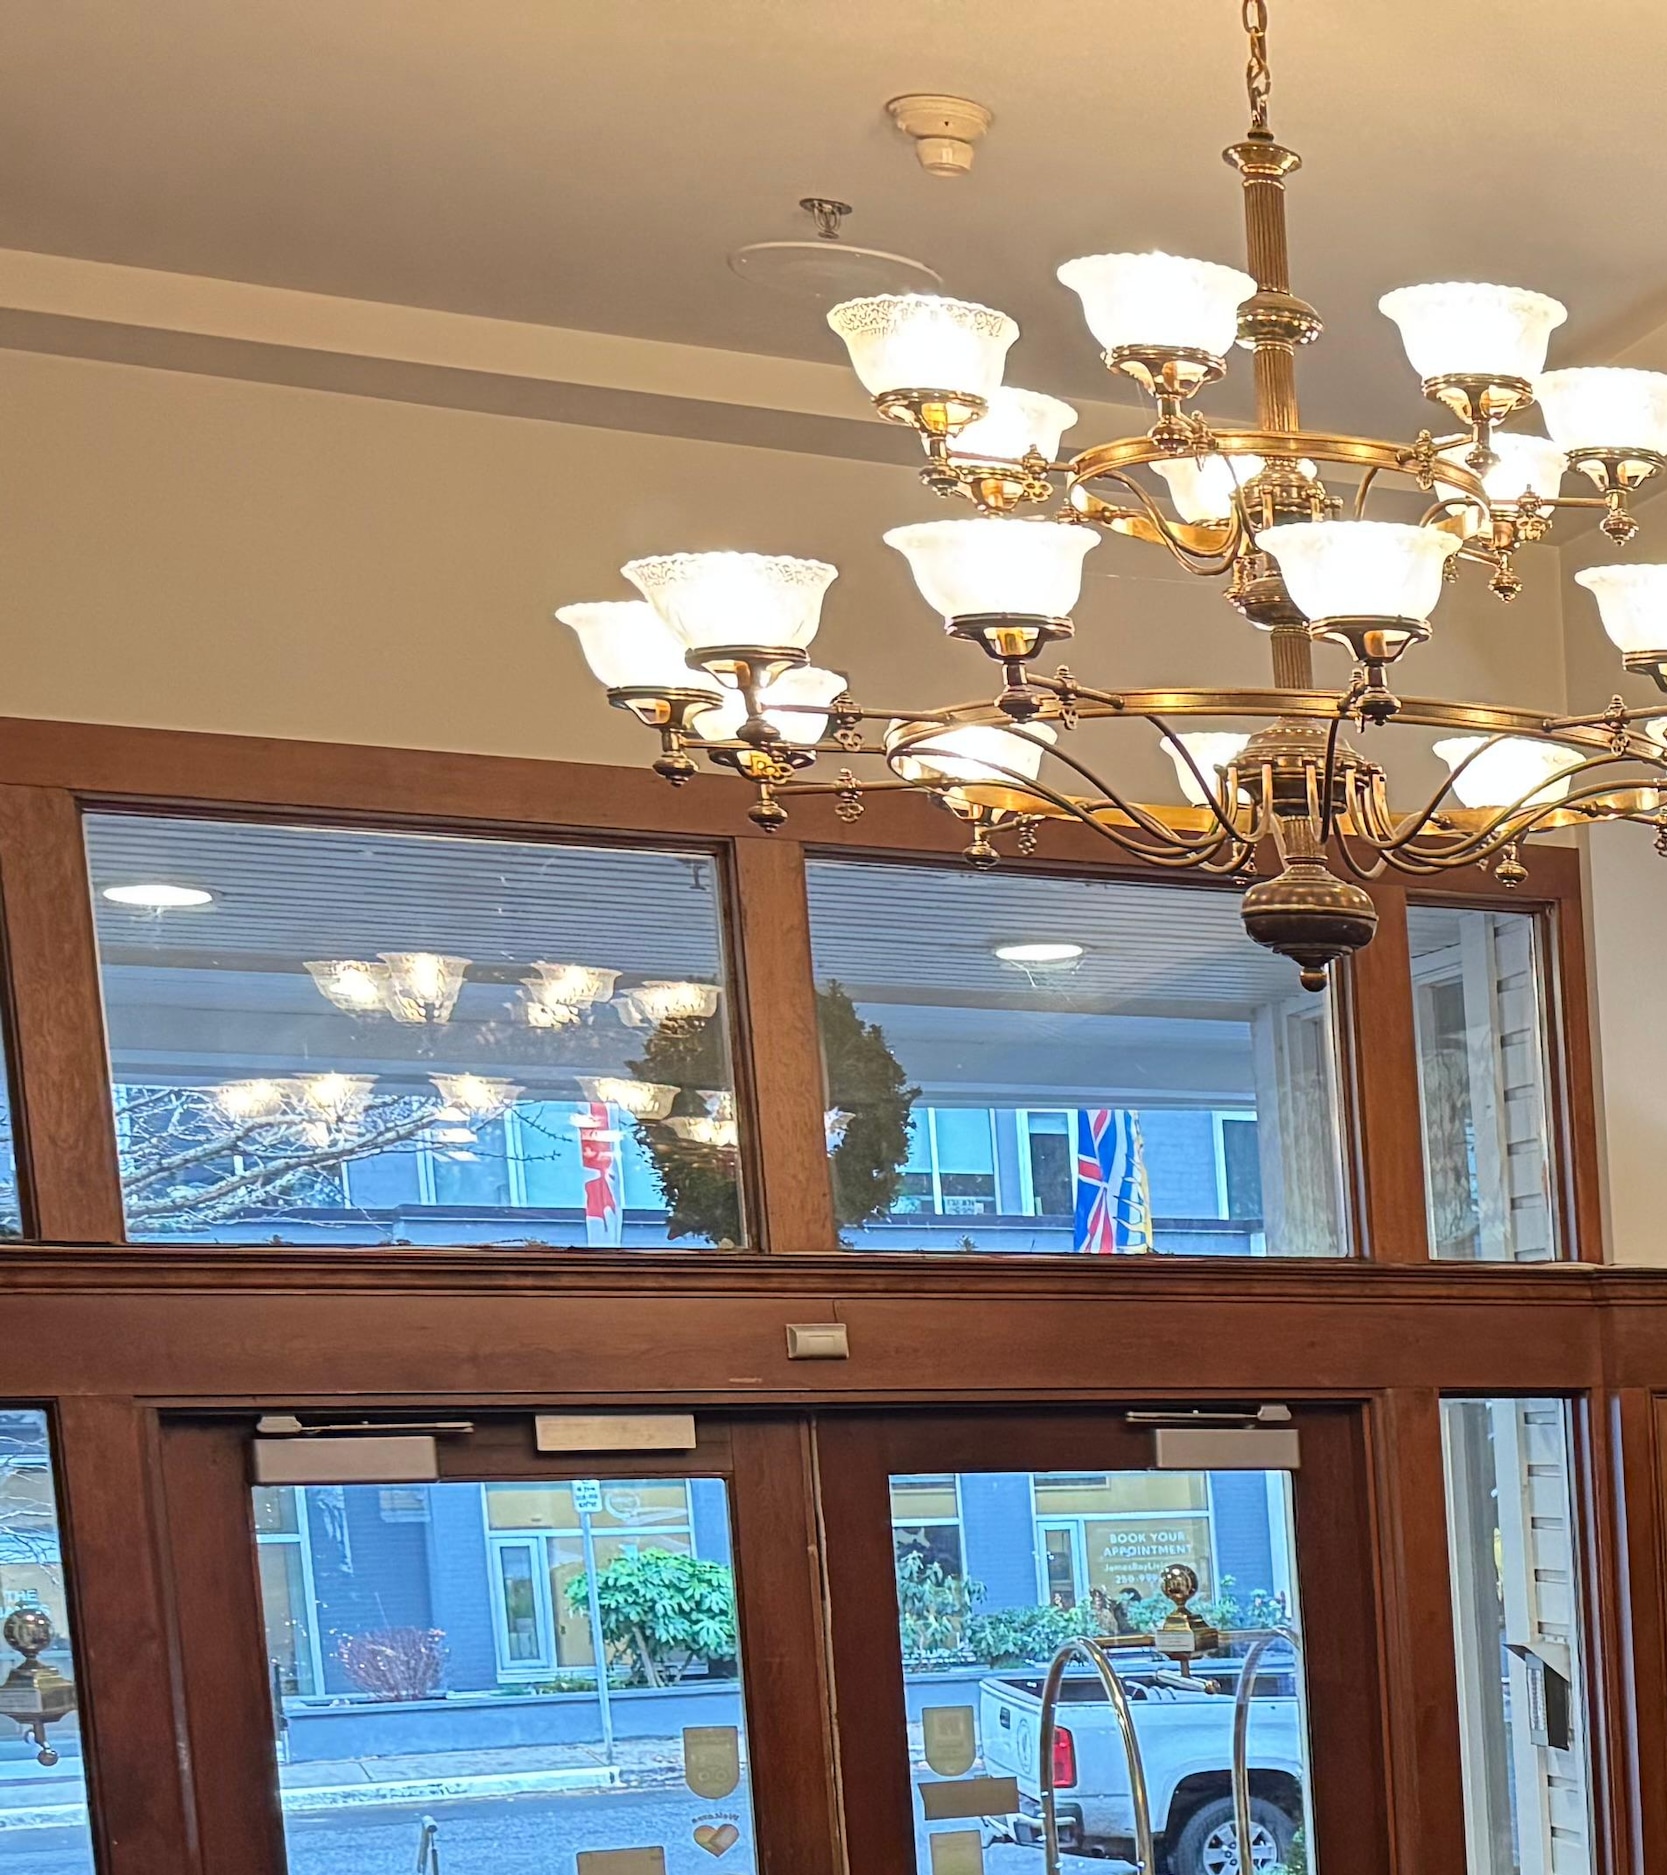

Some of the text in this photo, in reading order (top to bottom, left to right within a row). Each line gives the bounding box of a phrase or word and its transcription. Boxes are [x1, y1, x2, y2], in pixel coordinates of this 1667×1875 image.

[1110, 1531, 1186, 1544] BOOK YOUR
[1103, 1545, 1192, 1557] APPOINTMENT
